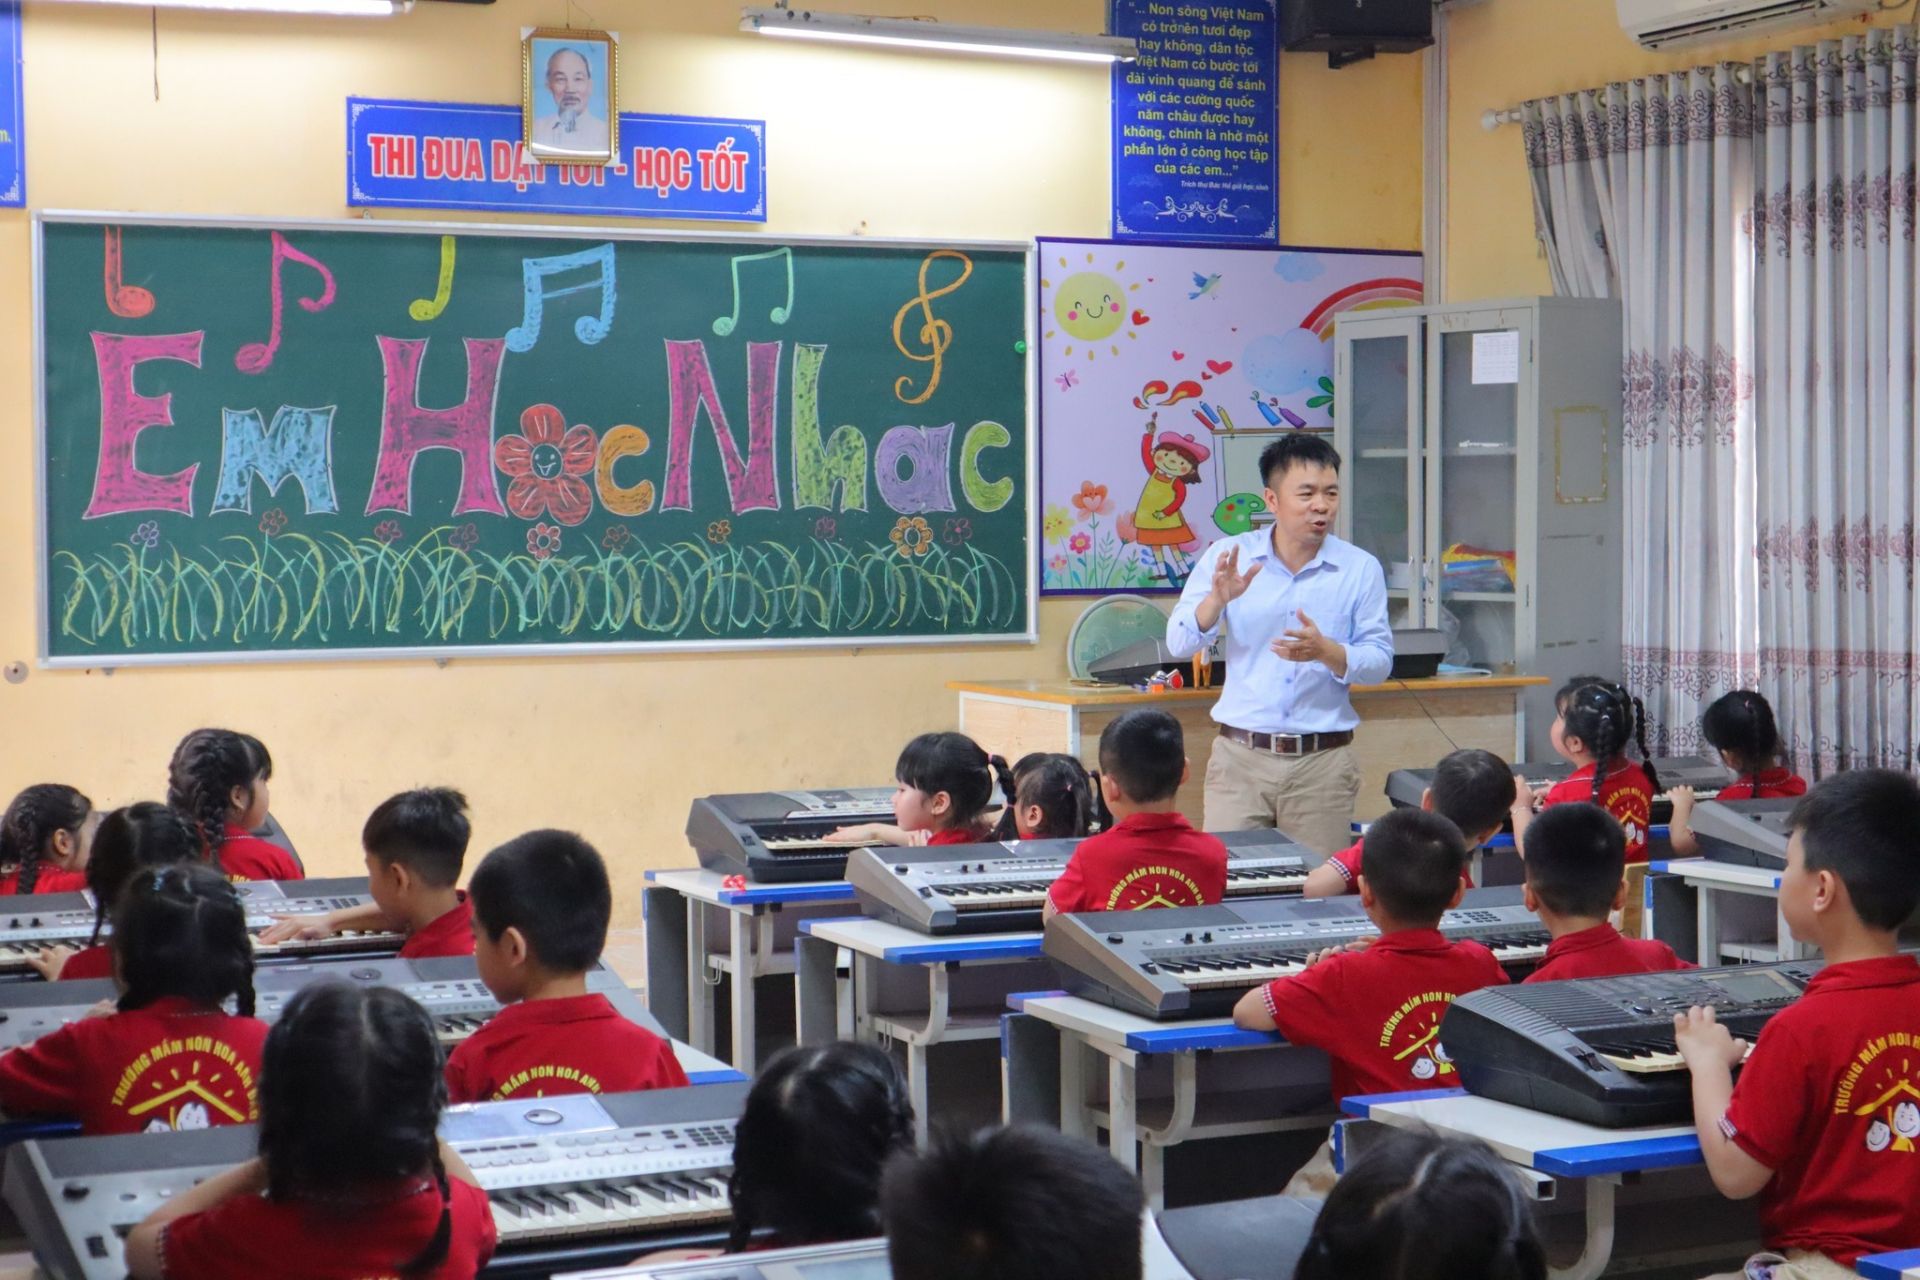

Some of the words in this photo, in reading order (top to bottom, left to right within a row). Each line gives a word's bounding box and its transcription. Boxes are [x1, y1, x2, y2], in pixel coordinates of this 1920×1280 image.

[1149, 3, 1174, 15] Non
[1177, 6, 1207, 20] sông
[1210, 6, 1234, 22] Việt
[1237, 9, 1264, 21] Nam
[1142, 20, 1157, 32] có
[1202, 24, 1225, 36] tươi
[1229, 24, 1251, 39] đẹp
[1140, 38, 1161, 53] hay
[1209, 41, 1231, 54] dân
[1235, 43, 1254, 58] tộc
[1135, 55, 1158, 70] Việt
[1161, 56, 1188, 69] Nam
[1191, 58, 1206, 70] có
[1209, 59, 1240, 72] bước
[1126, 72, 1145, 85] đài
[1148, 74, 1175, 86] vinh
[1178, 76, 1215, 91] quang
[1219, 75, 1235, 89] để
[1237, 79, 1266, 91] sánh
[1137, 90, 1156, 102] với
[1160, 91, 1181, 104] các
[1184, 93, 1222, 109] cường
[1225, 94, 1255, 108] quốc
[1138, 108, 1164, 120] năm
[1167, 110, 1197, 122] châu
[1200, 110, 1230, 126] được
[1234, 113, 1255, 127] hay
[1123, 125, 1165, 141] không,
[1206, 128, 1216, 141] là
[1220, 129, 1243, 142] nhờ
[1246, 131, 1269, 146] một
[1158, 143, 1177, 156] lớn
[1180, 142, 1188, 157] ở
[1191, 145, 1221, 161] công
[1224, 147, 1247, 161] học
[1250, 148, 1269, 164] tập
[367, 134, 416, 178] THI
[422, 137, 485, 181] ĐUA
[634, 146, 692, 198] HỌC
[697, 137, 749, 192] TỐT
[1154, 160, 1176, 174] của
[1180, 162, 1201, 175] các
[1149, 866, 1168, 875] NON
[1169, 868, 1185, 882] HOA
[1422, 991, 1442, 1003] NON
[1888, 1032, 1911, 1047] NON
[185, 1035, 212, 1053] NON
[213, 1040, 237, 1066] HOA
[530, 1065, 554, 1079] NON
[556, 1066, 580, 1081] HOA
